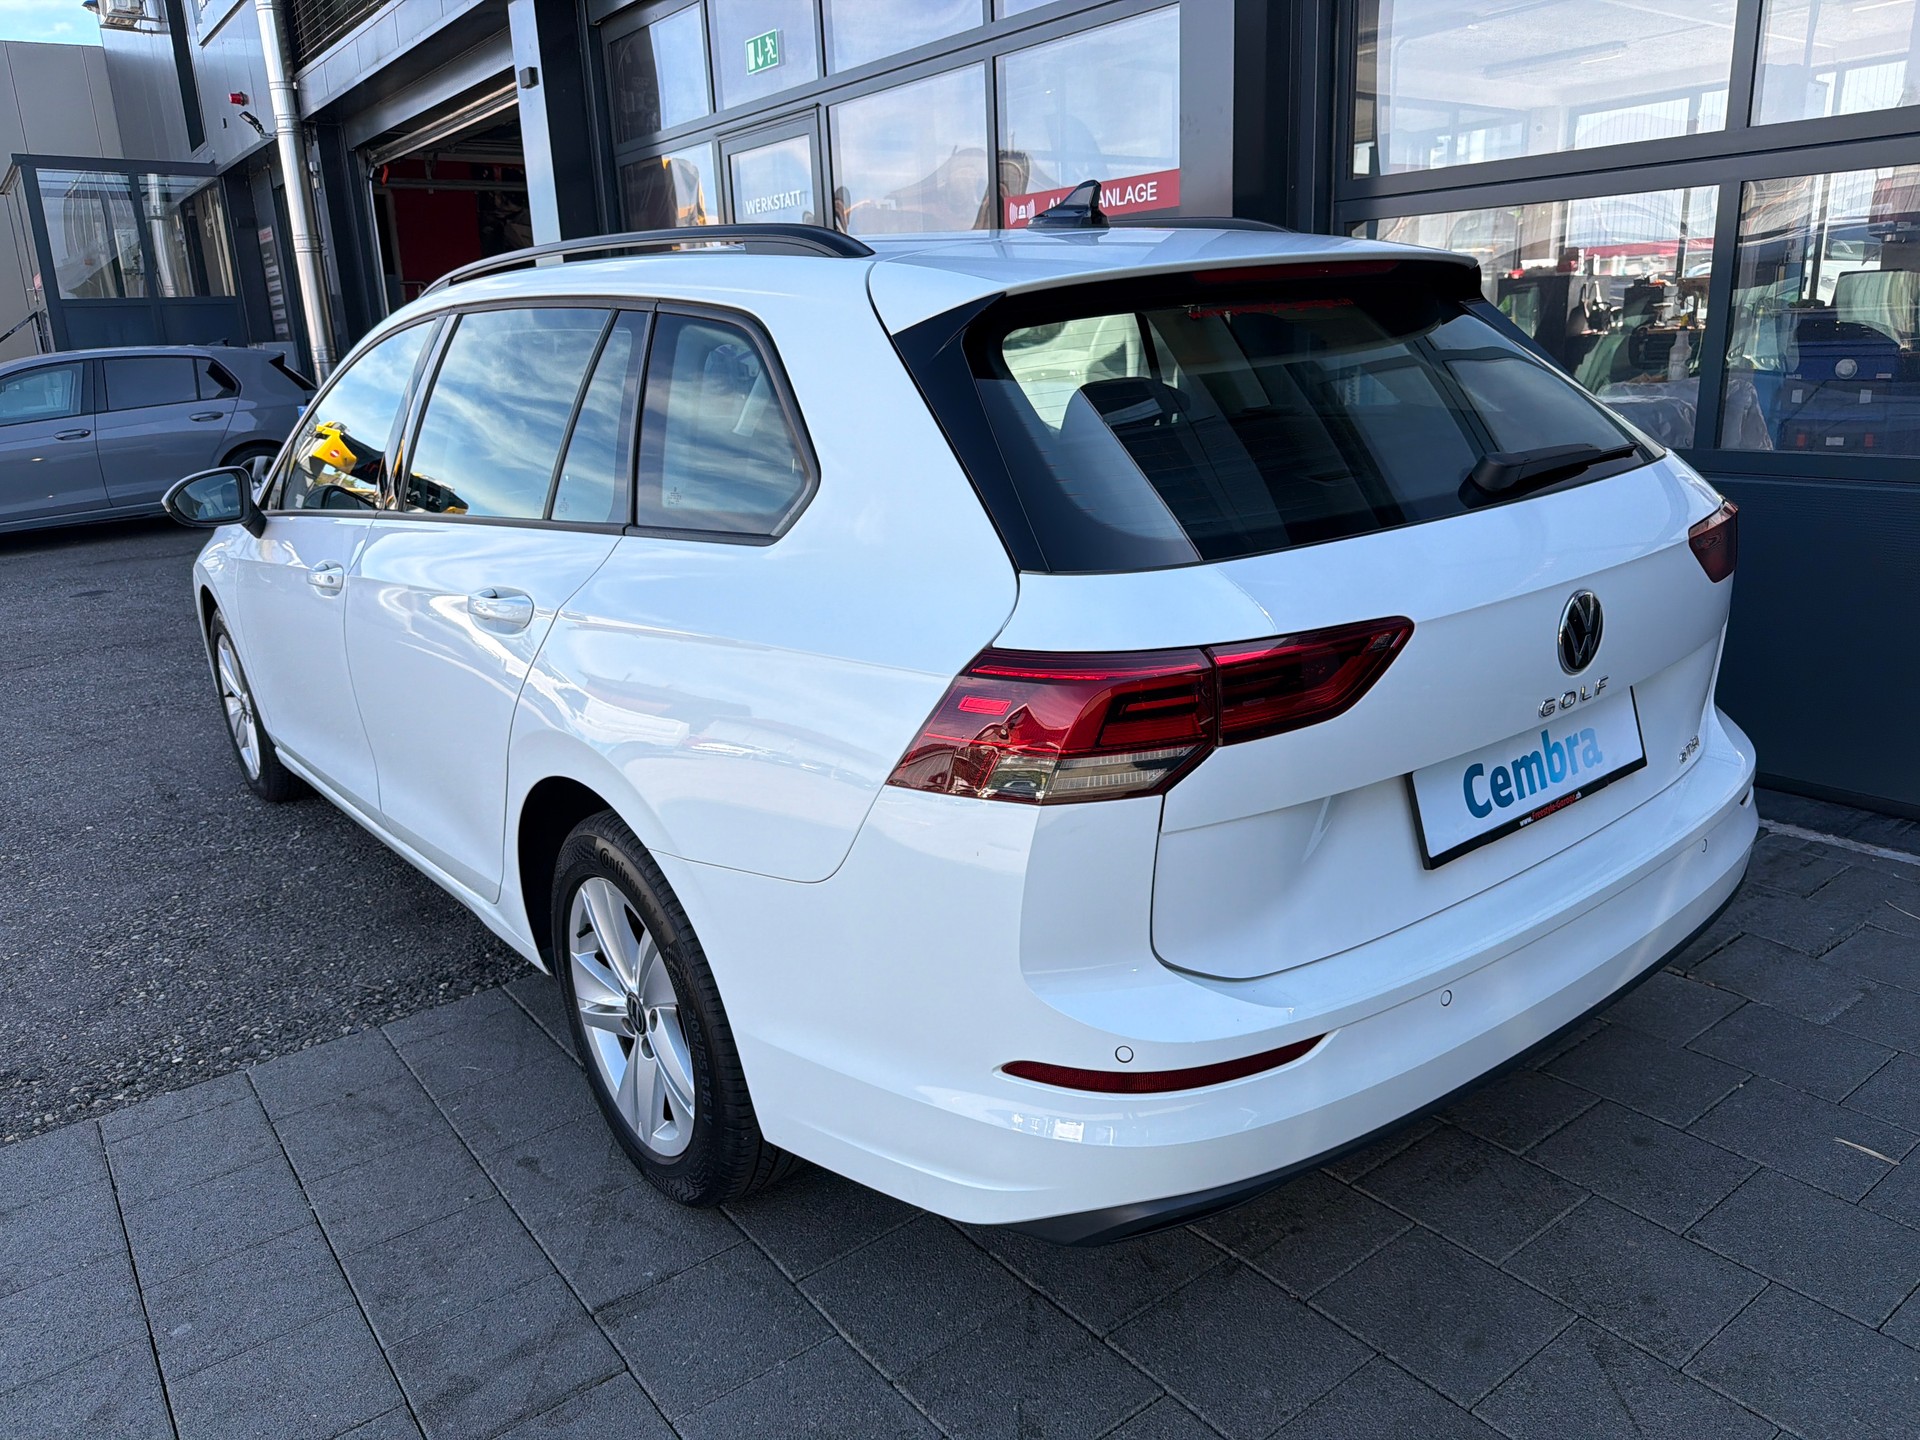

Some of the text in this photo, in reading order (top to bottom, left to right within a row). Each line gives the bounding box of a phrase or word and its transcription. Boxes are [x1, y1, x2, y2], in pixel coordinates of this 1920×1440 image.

[745, 190, 801, 215] WERKSTATT
[1539, 675, 1609, 717] GOLF
[1463, 727, 1603, 819] Cembra
